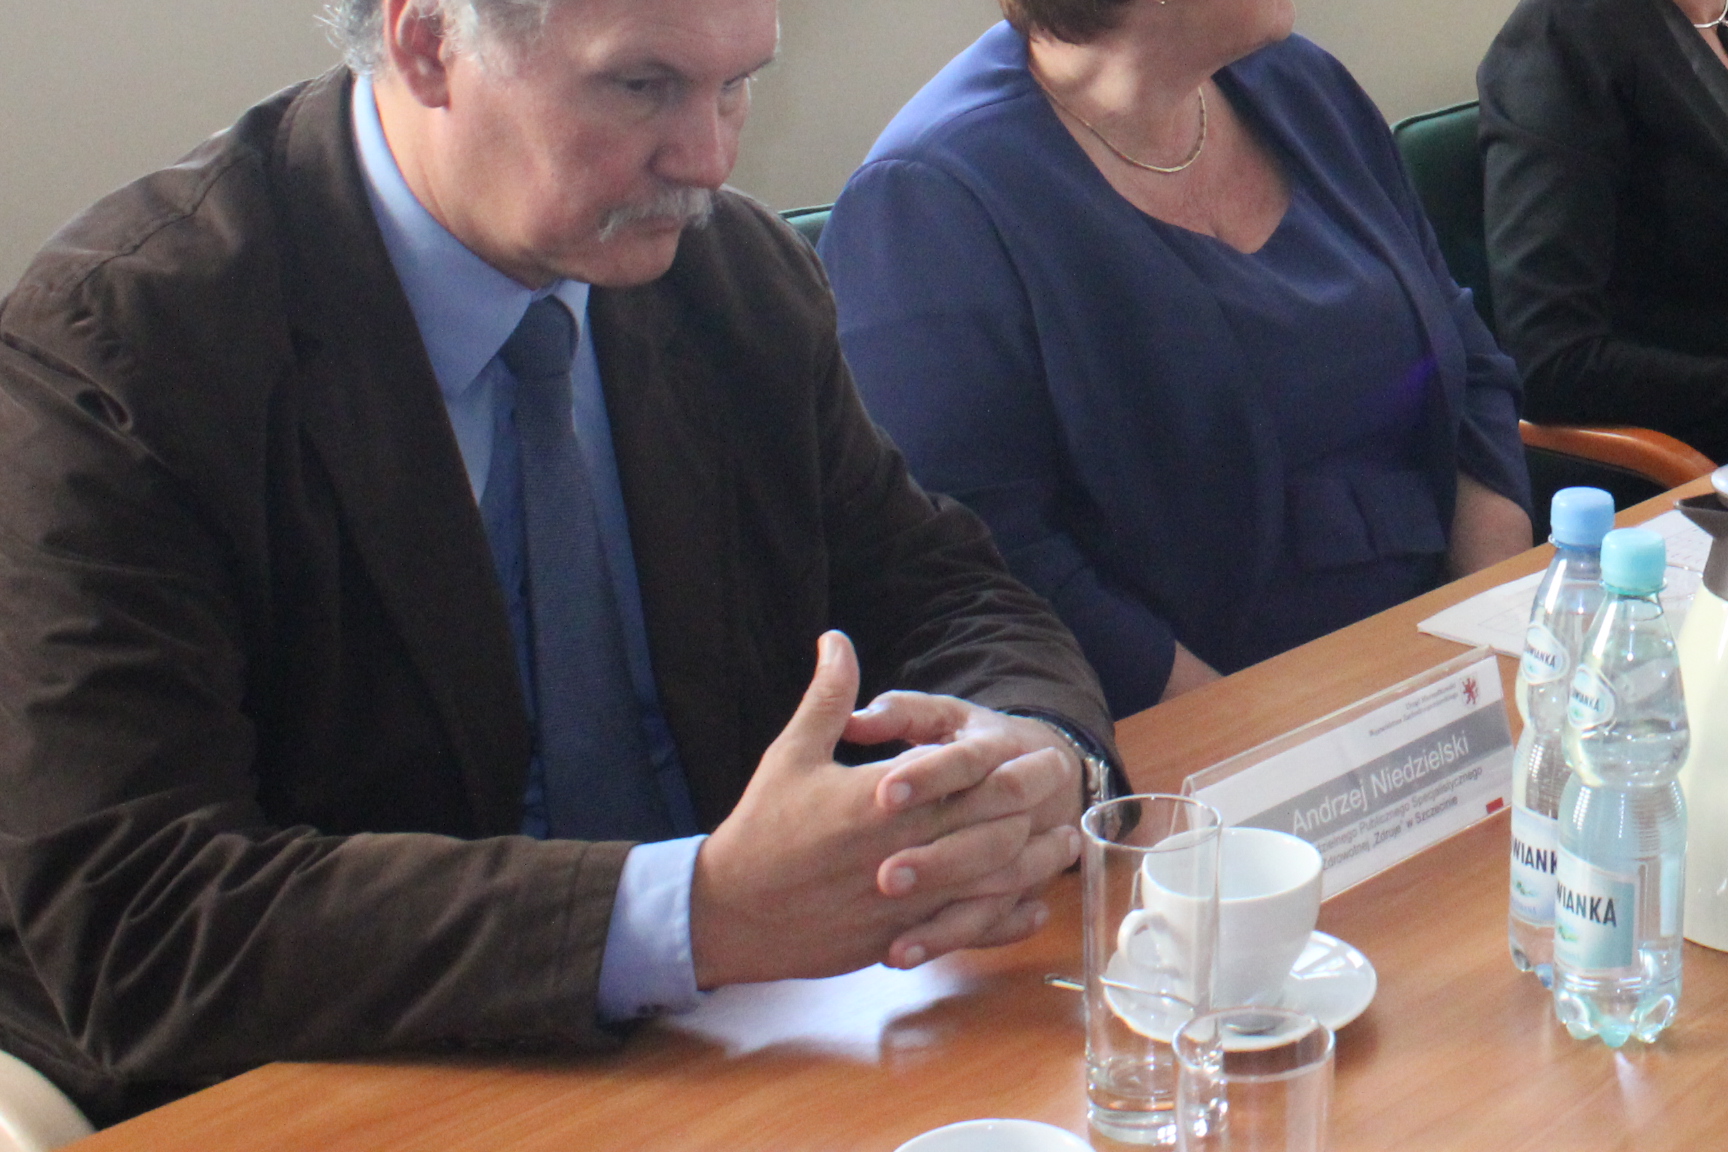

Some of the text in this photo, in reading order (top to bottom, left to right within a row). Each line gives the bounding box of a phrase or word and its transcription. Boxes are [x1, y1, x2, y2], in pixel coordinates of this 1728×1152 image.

[1292, 730, 1470, 834] Andrzej Niedzielski
[1359, 802, 1411, 833] Publicznego
[1411, 766, 1483, 808] Specjalistycznego
[1322, 839, 1371, 871] Zdrowotnej
[1414, 796, 1459, 824] Szczecinie
